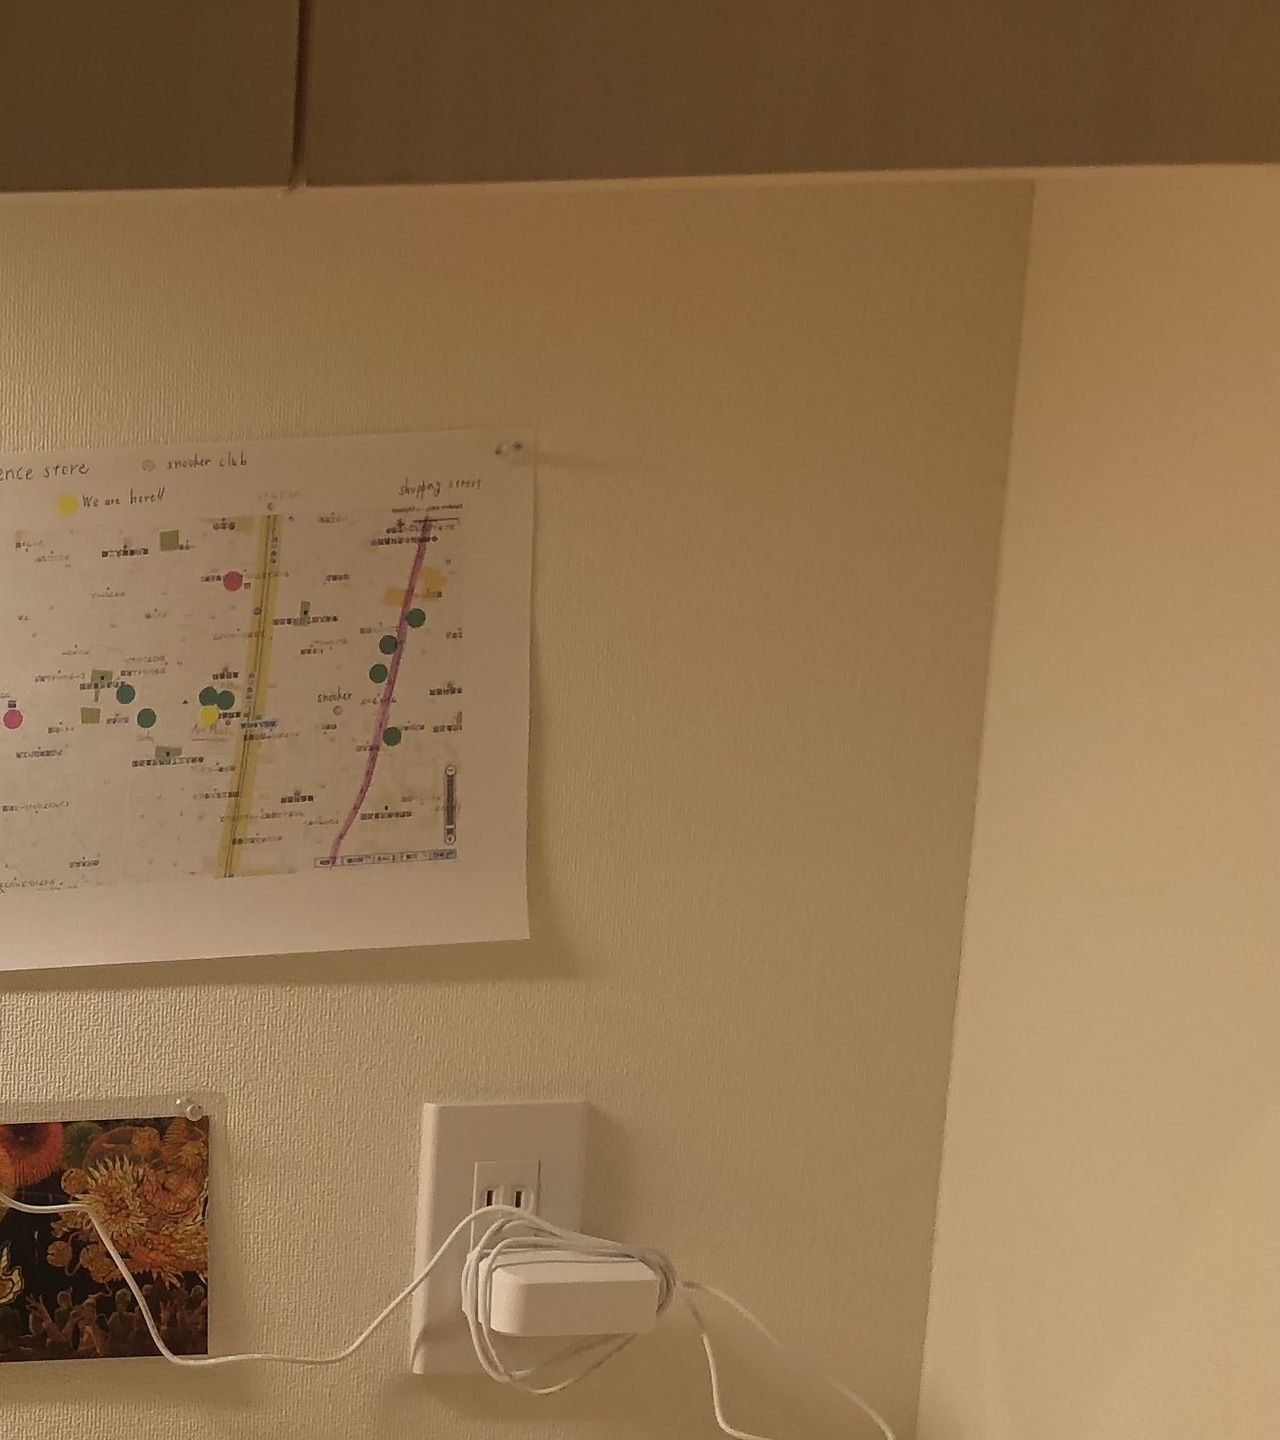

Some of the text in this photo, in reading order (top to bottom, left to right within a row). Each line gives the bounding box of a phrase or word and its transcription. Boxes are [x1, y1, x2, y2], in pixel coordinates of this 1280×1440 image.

[219, 453, 248, 468] club
[43, 462, 90, 479] store
[82, 495, 99, 507] We
